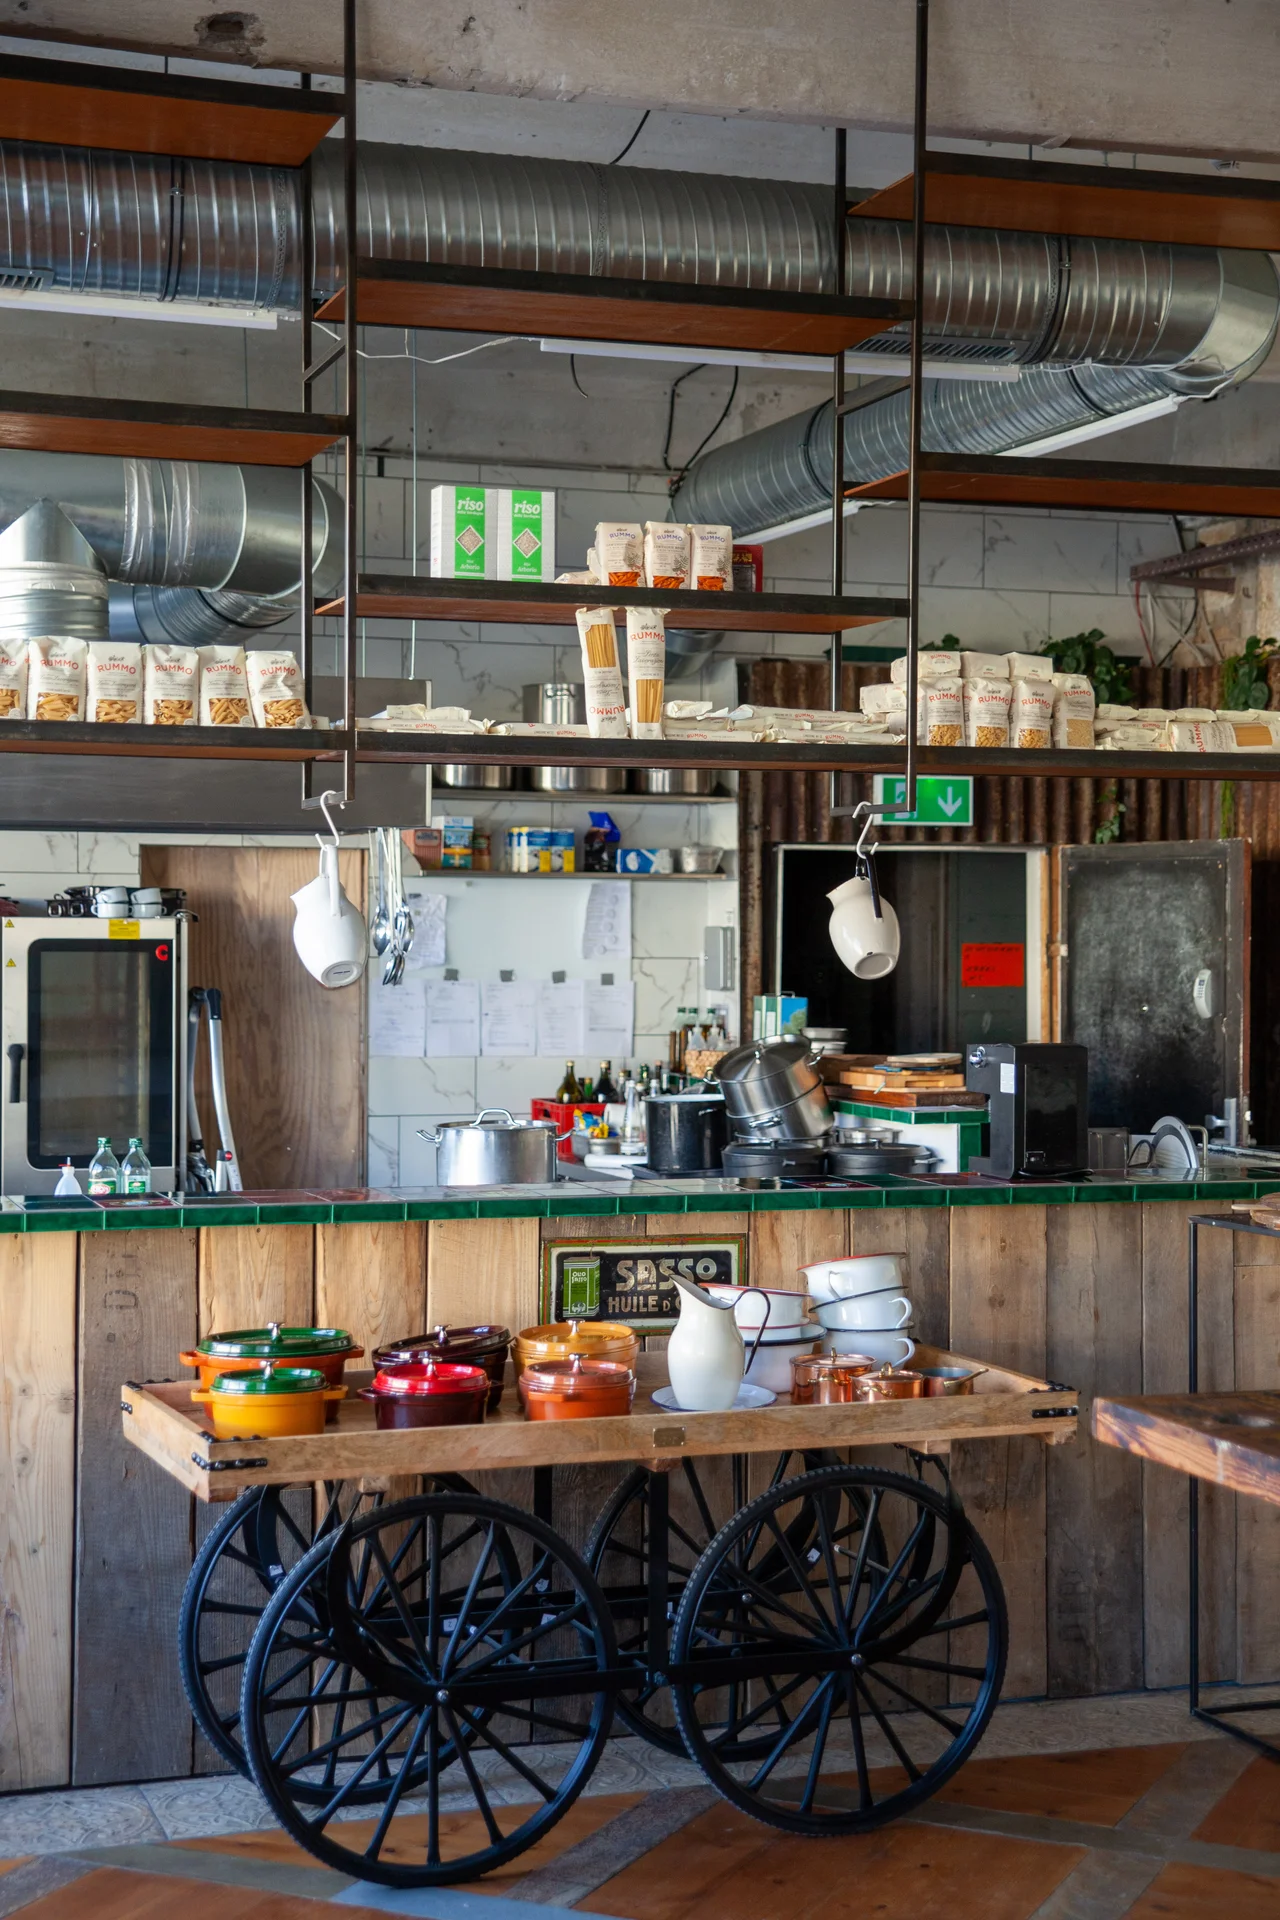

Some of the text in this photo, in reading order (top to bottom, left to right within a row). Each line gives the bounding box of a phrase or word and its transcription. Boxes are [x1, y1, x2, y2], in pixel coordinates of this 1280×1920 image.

[457, 497, 484, 511] riso
[514, 500, 540, 514] riso
[656, 534, 683, 542] RUMMO
[631, 631, 665, 642] RUMMO
[40, 659, 79, 670] RUMMO
[97, 663, 137, 674] RUMMO
[154, 664, 193, 675] RUMMO
[205, 664, 242, 675] RUMMO
[259, 666, 296, 677] RUMMO
[928, 693, 961, 703] RUMMO
[978, 695, 1009, 706] RUMMO
[1022, 698, 1051, 709] RUMMO
[590, 705, 625, 715] RUMMO
[824, 734, 846, 742] RUMMO
[615, 1257, 718, 1292] SASSO
[608, 1295, 659, 1313] HUILE
